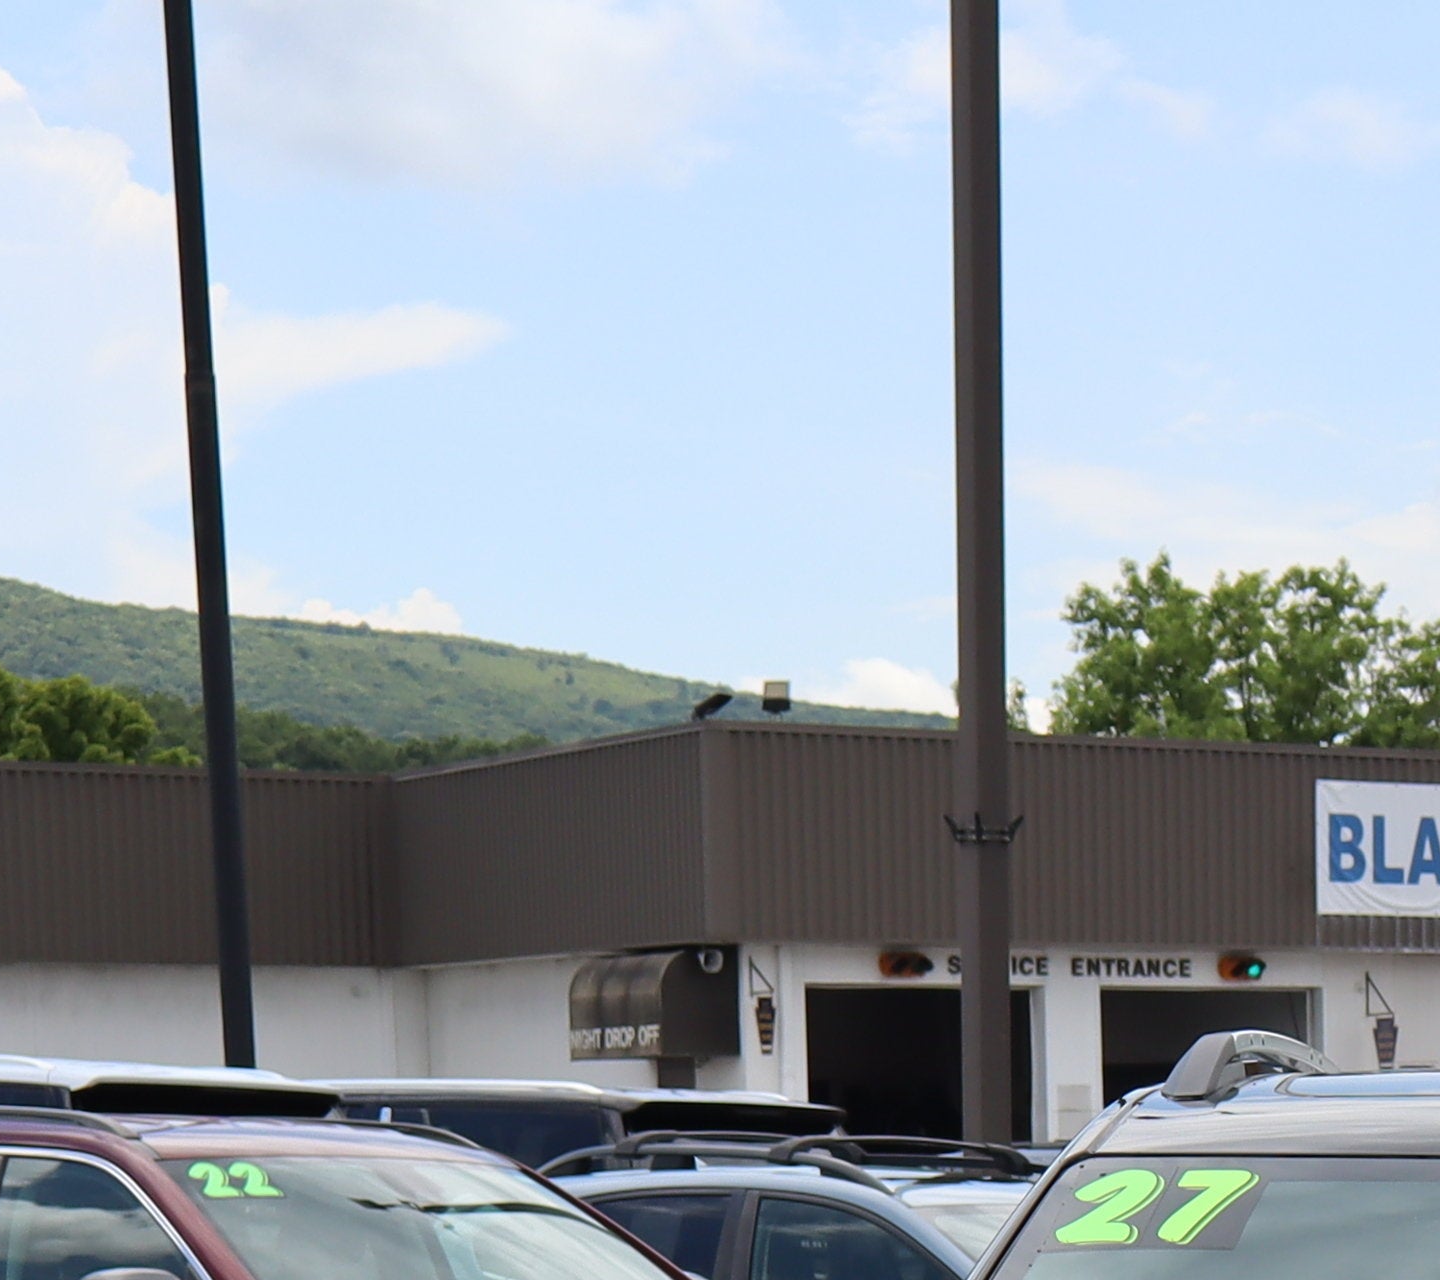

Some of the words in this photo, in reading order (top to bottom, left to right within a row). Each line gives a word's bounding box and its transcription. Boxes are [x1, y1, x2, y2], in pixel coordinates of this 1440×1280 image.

[947, 955, 1049, 976] SICE
[1071, 957, 1192, 978] ENTRANCE
[570, 1028, 602, 1050] NIGHT
[604, 1026, 635, 1048] DROP
[638, 1024, 660, 1046] OFF
[188, 1161, 286, 1198] 22
[1055, 1168, 1260, 1245] 27
